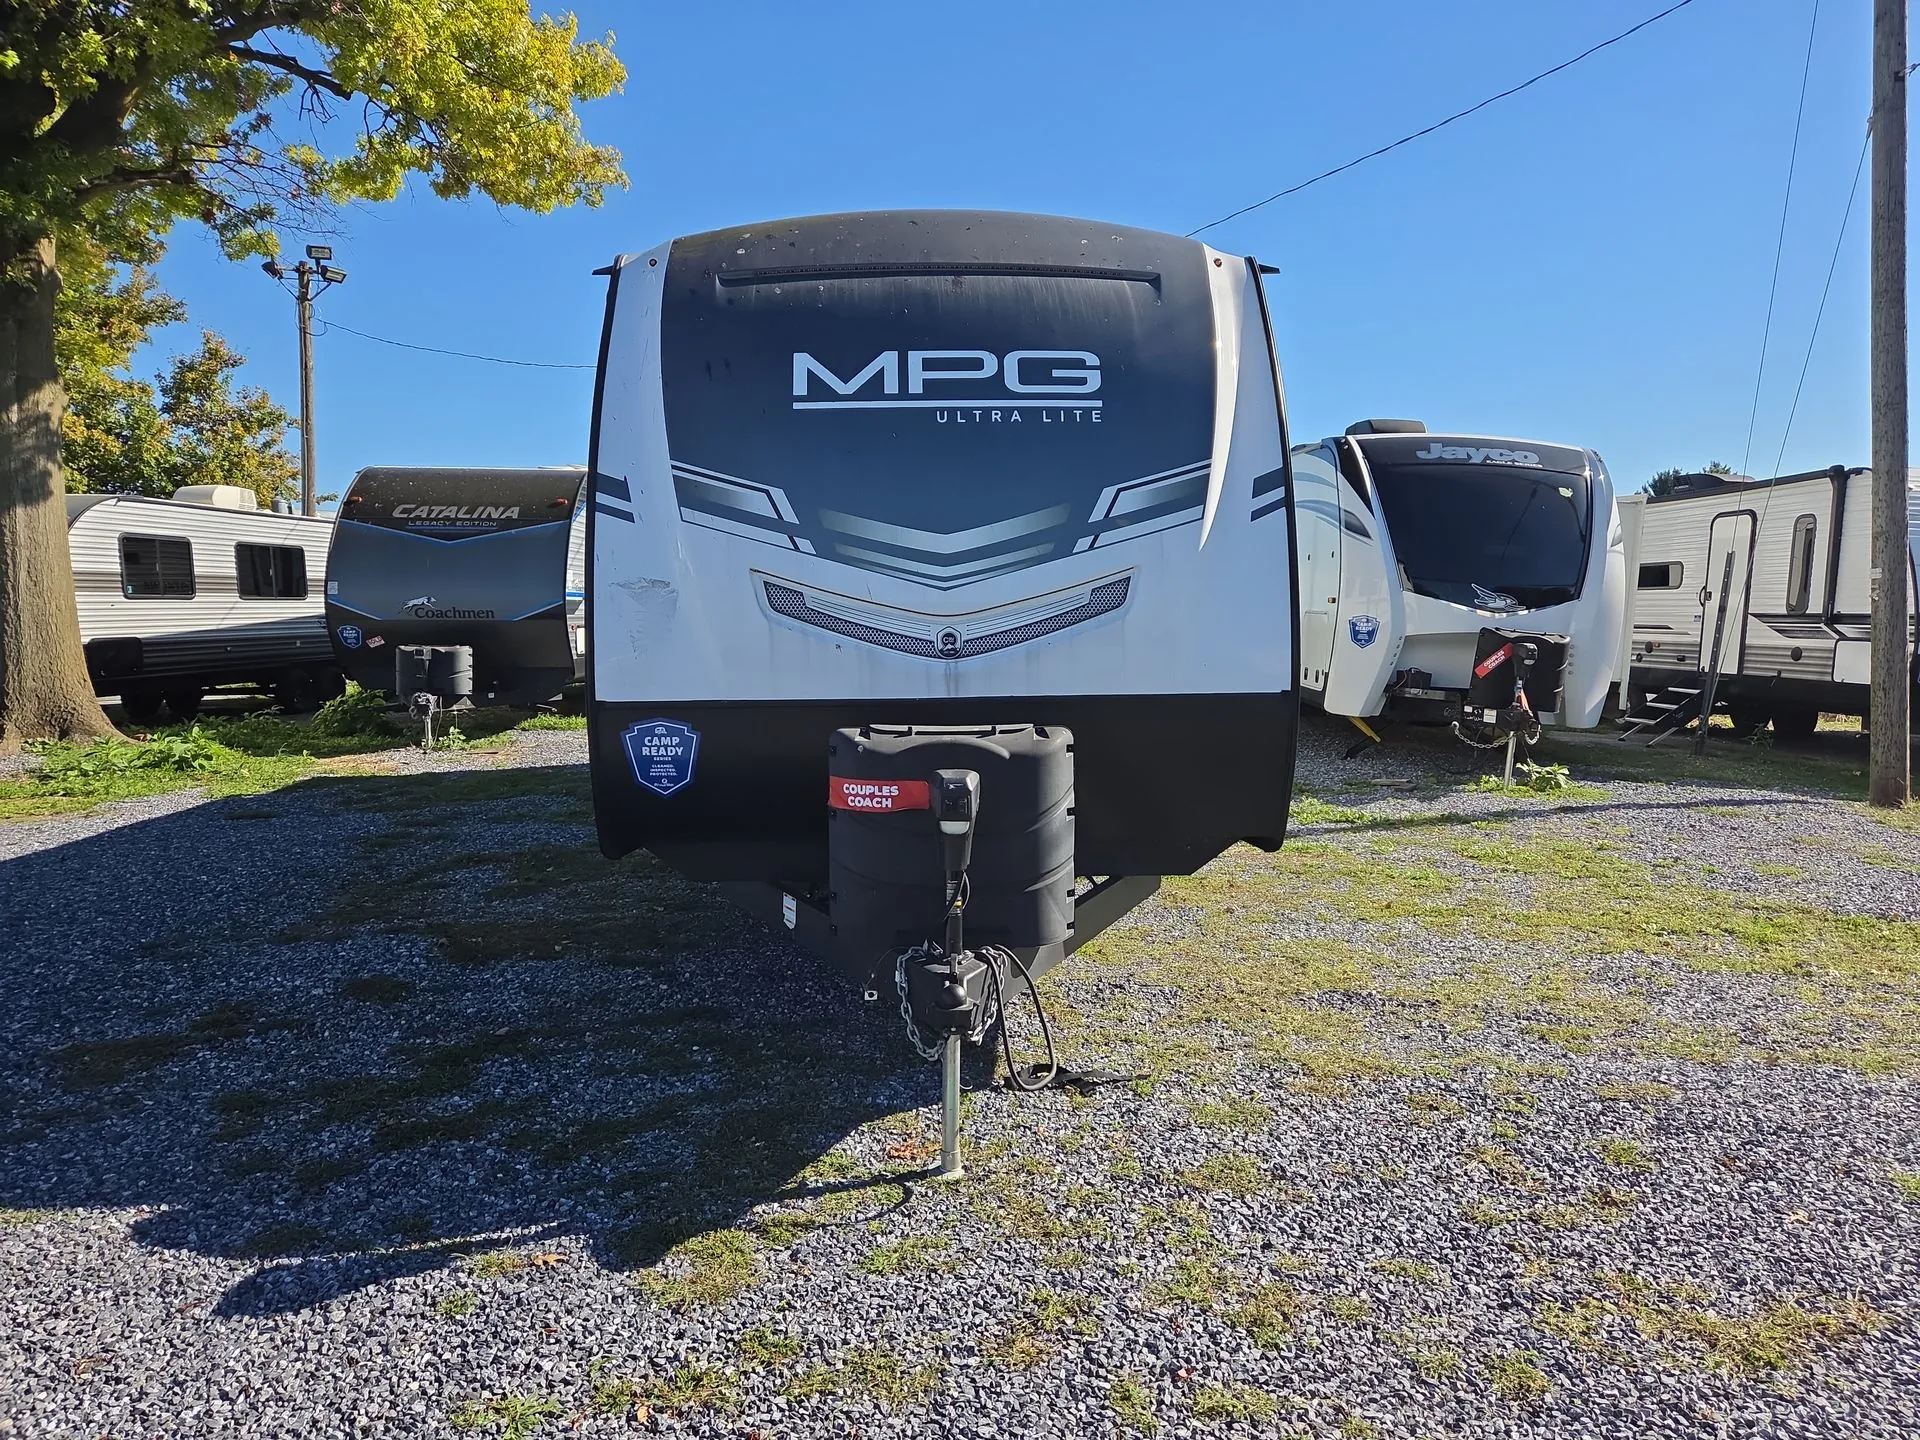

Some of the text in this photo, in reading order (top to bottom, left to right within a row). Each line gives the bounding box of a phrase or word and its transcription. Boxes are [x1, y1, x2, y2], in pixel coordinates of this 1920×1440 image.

[792, 350, 1102, 396] MPG
[936, 410, 1102, 424] ULTRA LITE
[1415, 442, 1540, 464] Jayco
[392, 503, 521, 519] CATALINA
[414, 606, 495, 619] Coachmen
[1483, 649, 1505, 667] COUPLES
[1488, 655, 1506, 669] COACH
[644, 736, 680, 746] CAMP
[641, 746, 684, 756] READY
[843, 783, 899, 797] COUPLES
[847, 796, 892, 808] COACH
